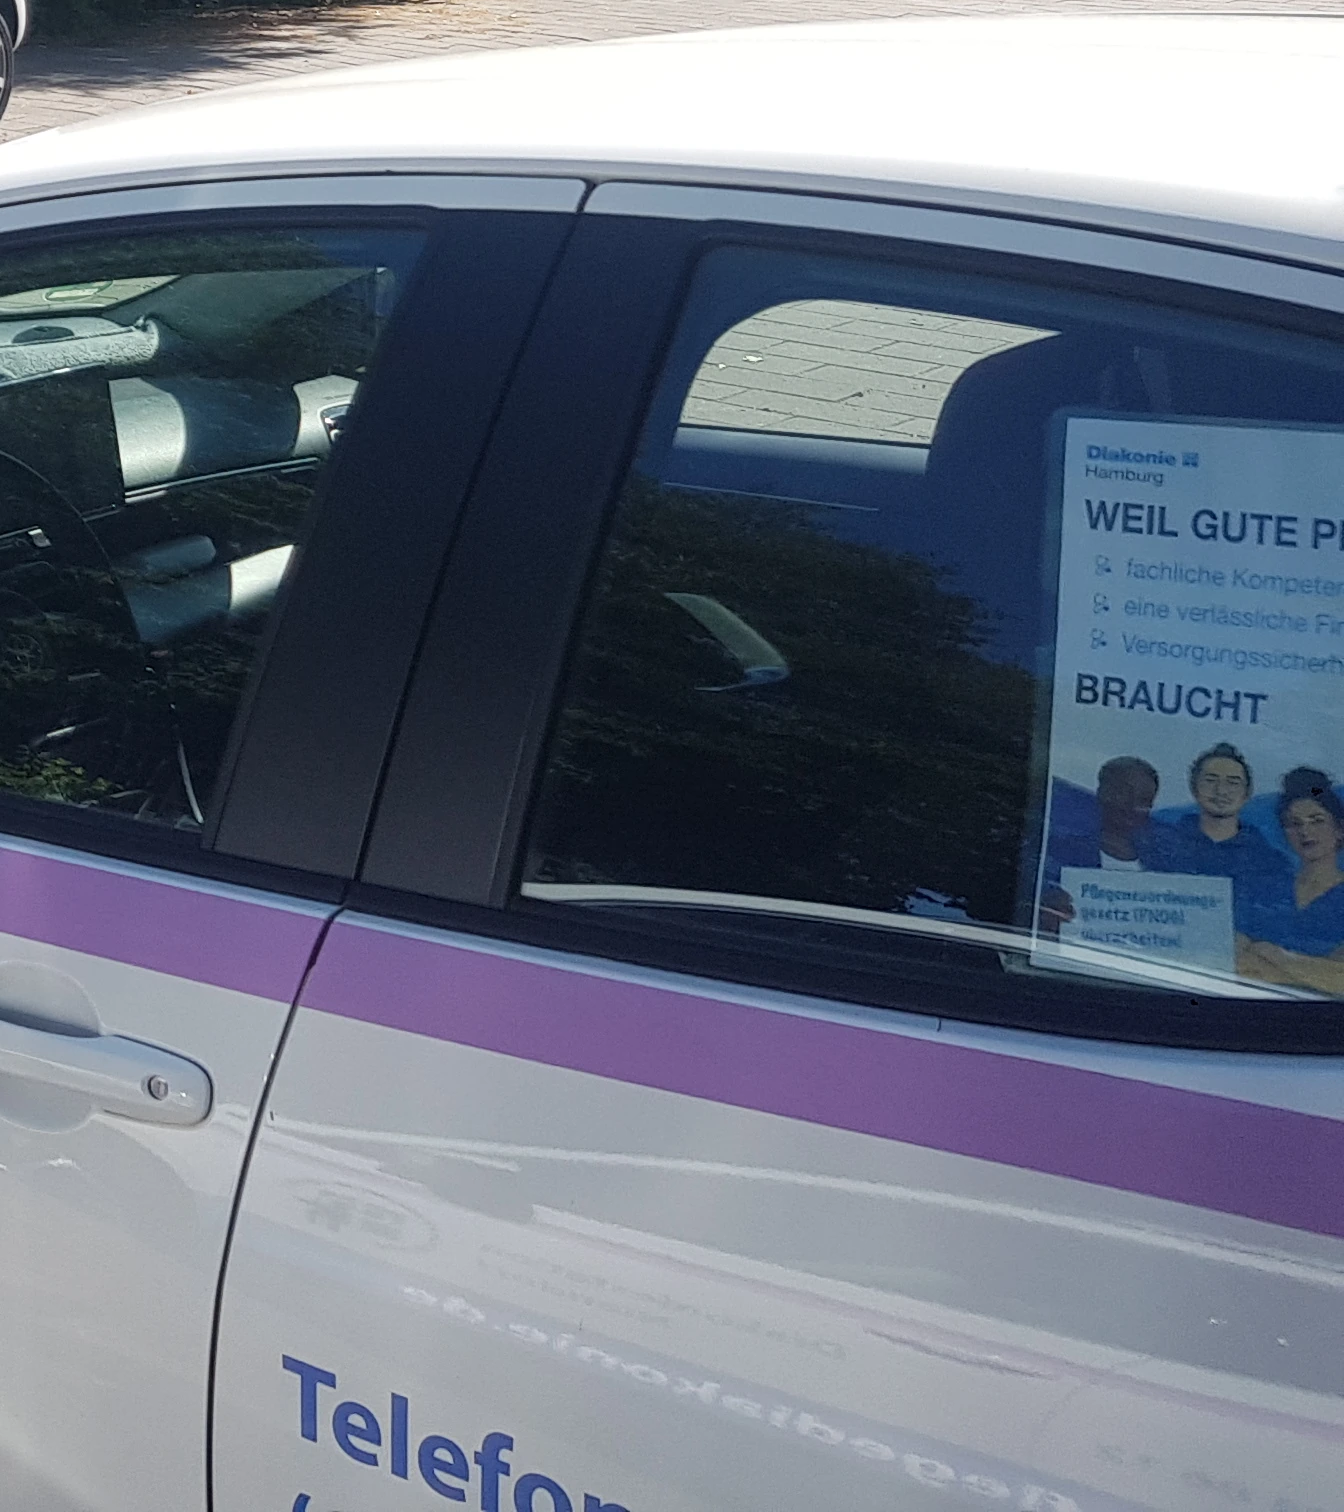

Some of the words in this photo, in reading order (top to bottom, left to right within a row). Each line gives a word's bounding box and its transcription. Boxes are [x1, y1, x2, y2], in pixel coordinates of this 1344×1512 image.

[1085, 443, 1177, 468] Diakonie
[1084, 464, 1164, 488] Hamburg
[1084, 498, 1179, 538] WEIL
[1191, 508, 1299, 548] GUTE
[1313, 516, 1344, 551] P
[1124, 557, 1225, 587] fachliche
[1123, 596, 1171, 620] eine
[1176, 601, 1308, 634] verlässliche
[1075, 672, 1269, 724] BRAUCHT
[281, 1353, 633, 1512] Telefo
